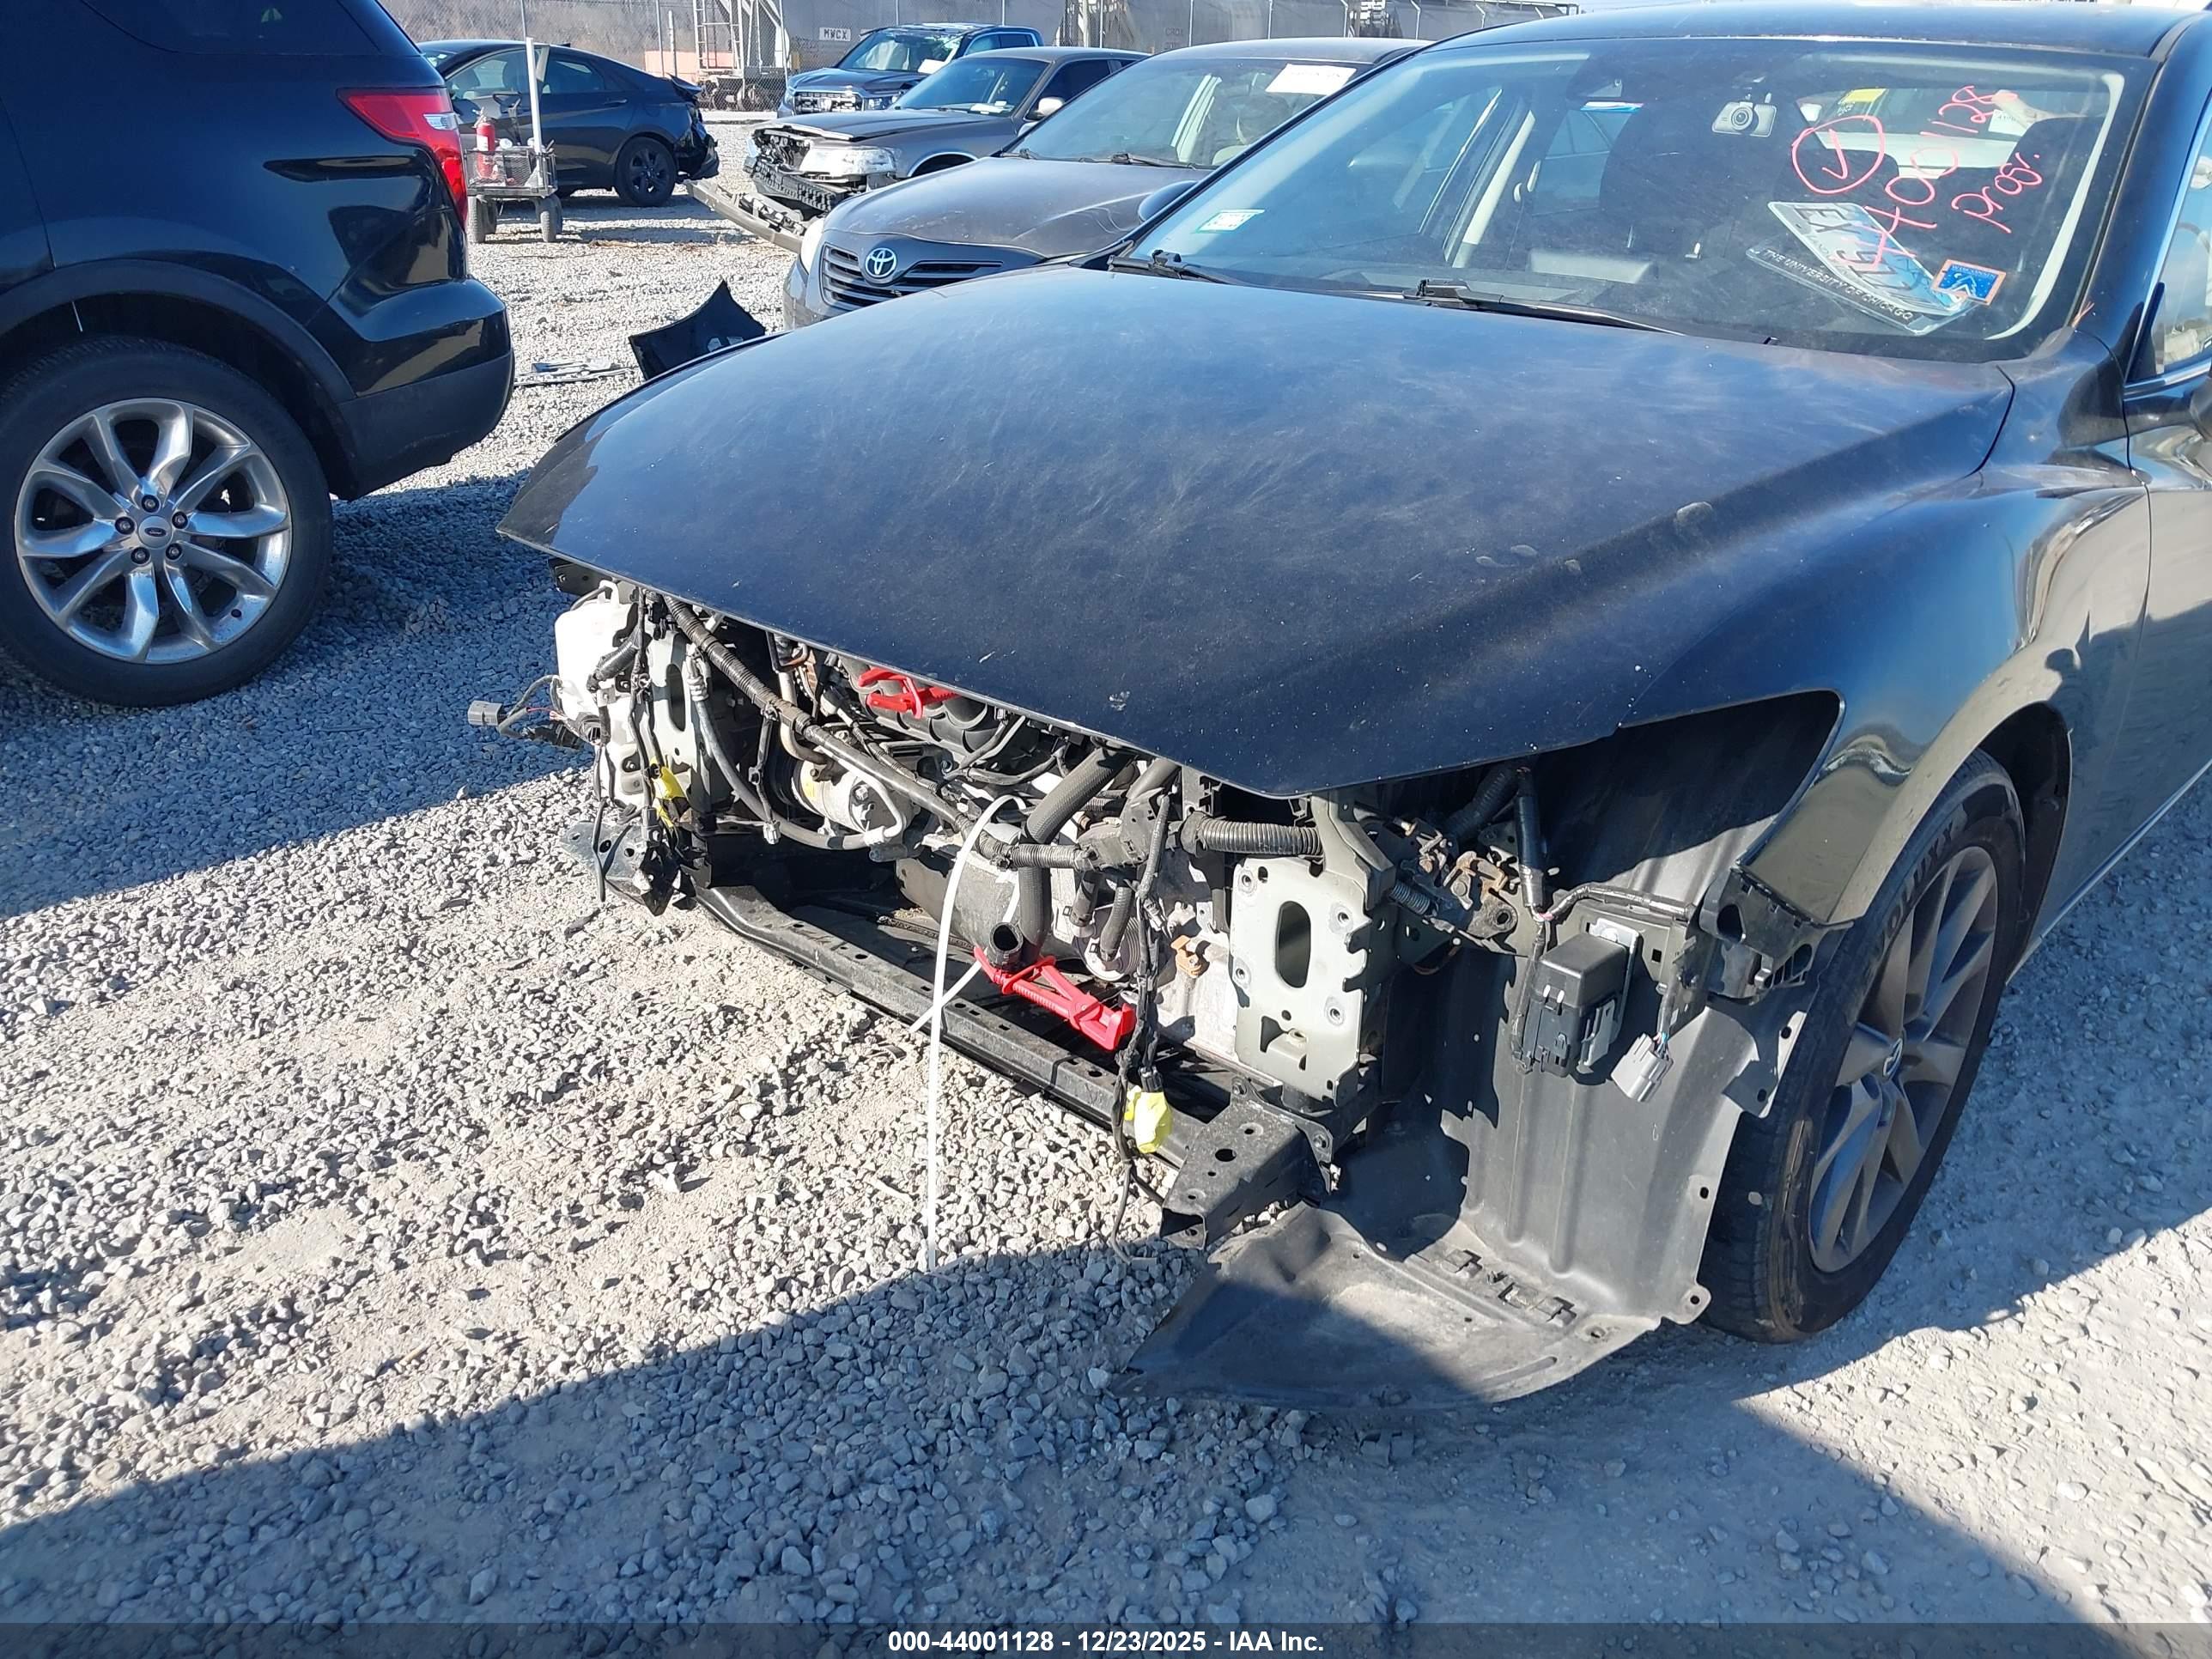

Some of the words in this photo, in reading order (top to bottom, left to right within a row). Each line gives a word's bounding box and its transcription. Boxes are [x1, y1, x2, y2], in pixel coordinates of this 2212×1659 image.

[1765, 248, 1786, 264] THE
[1784, 258, 1847, 291] UNIVERSITY
[1861, 291, 1914, 320] CHICAGO
